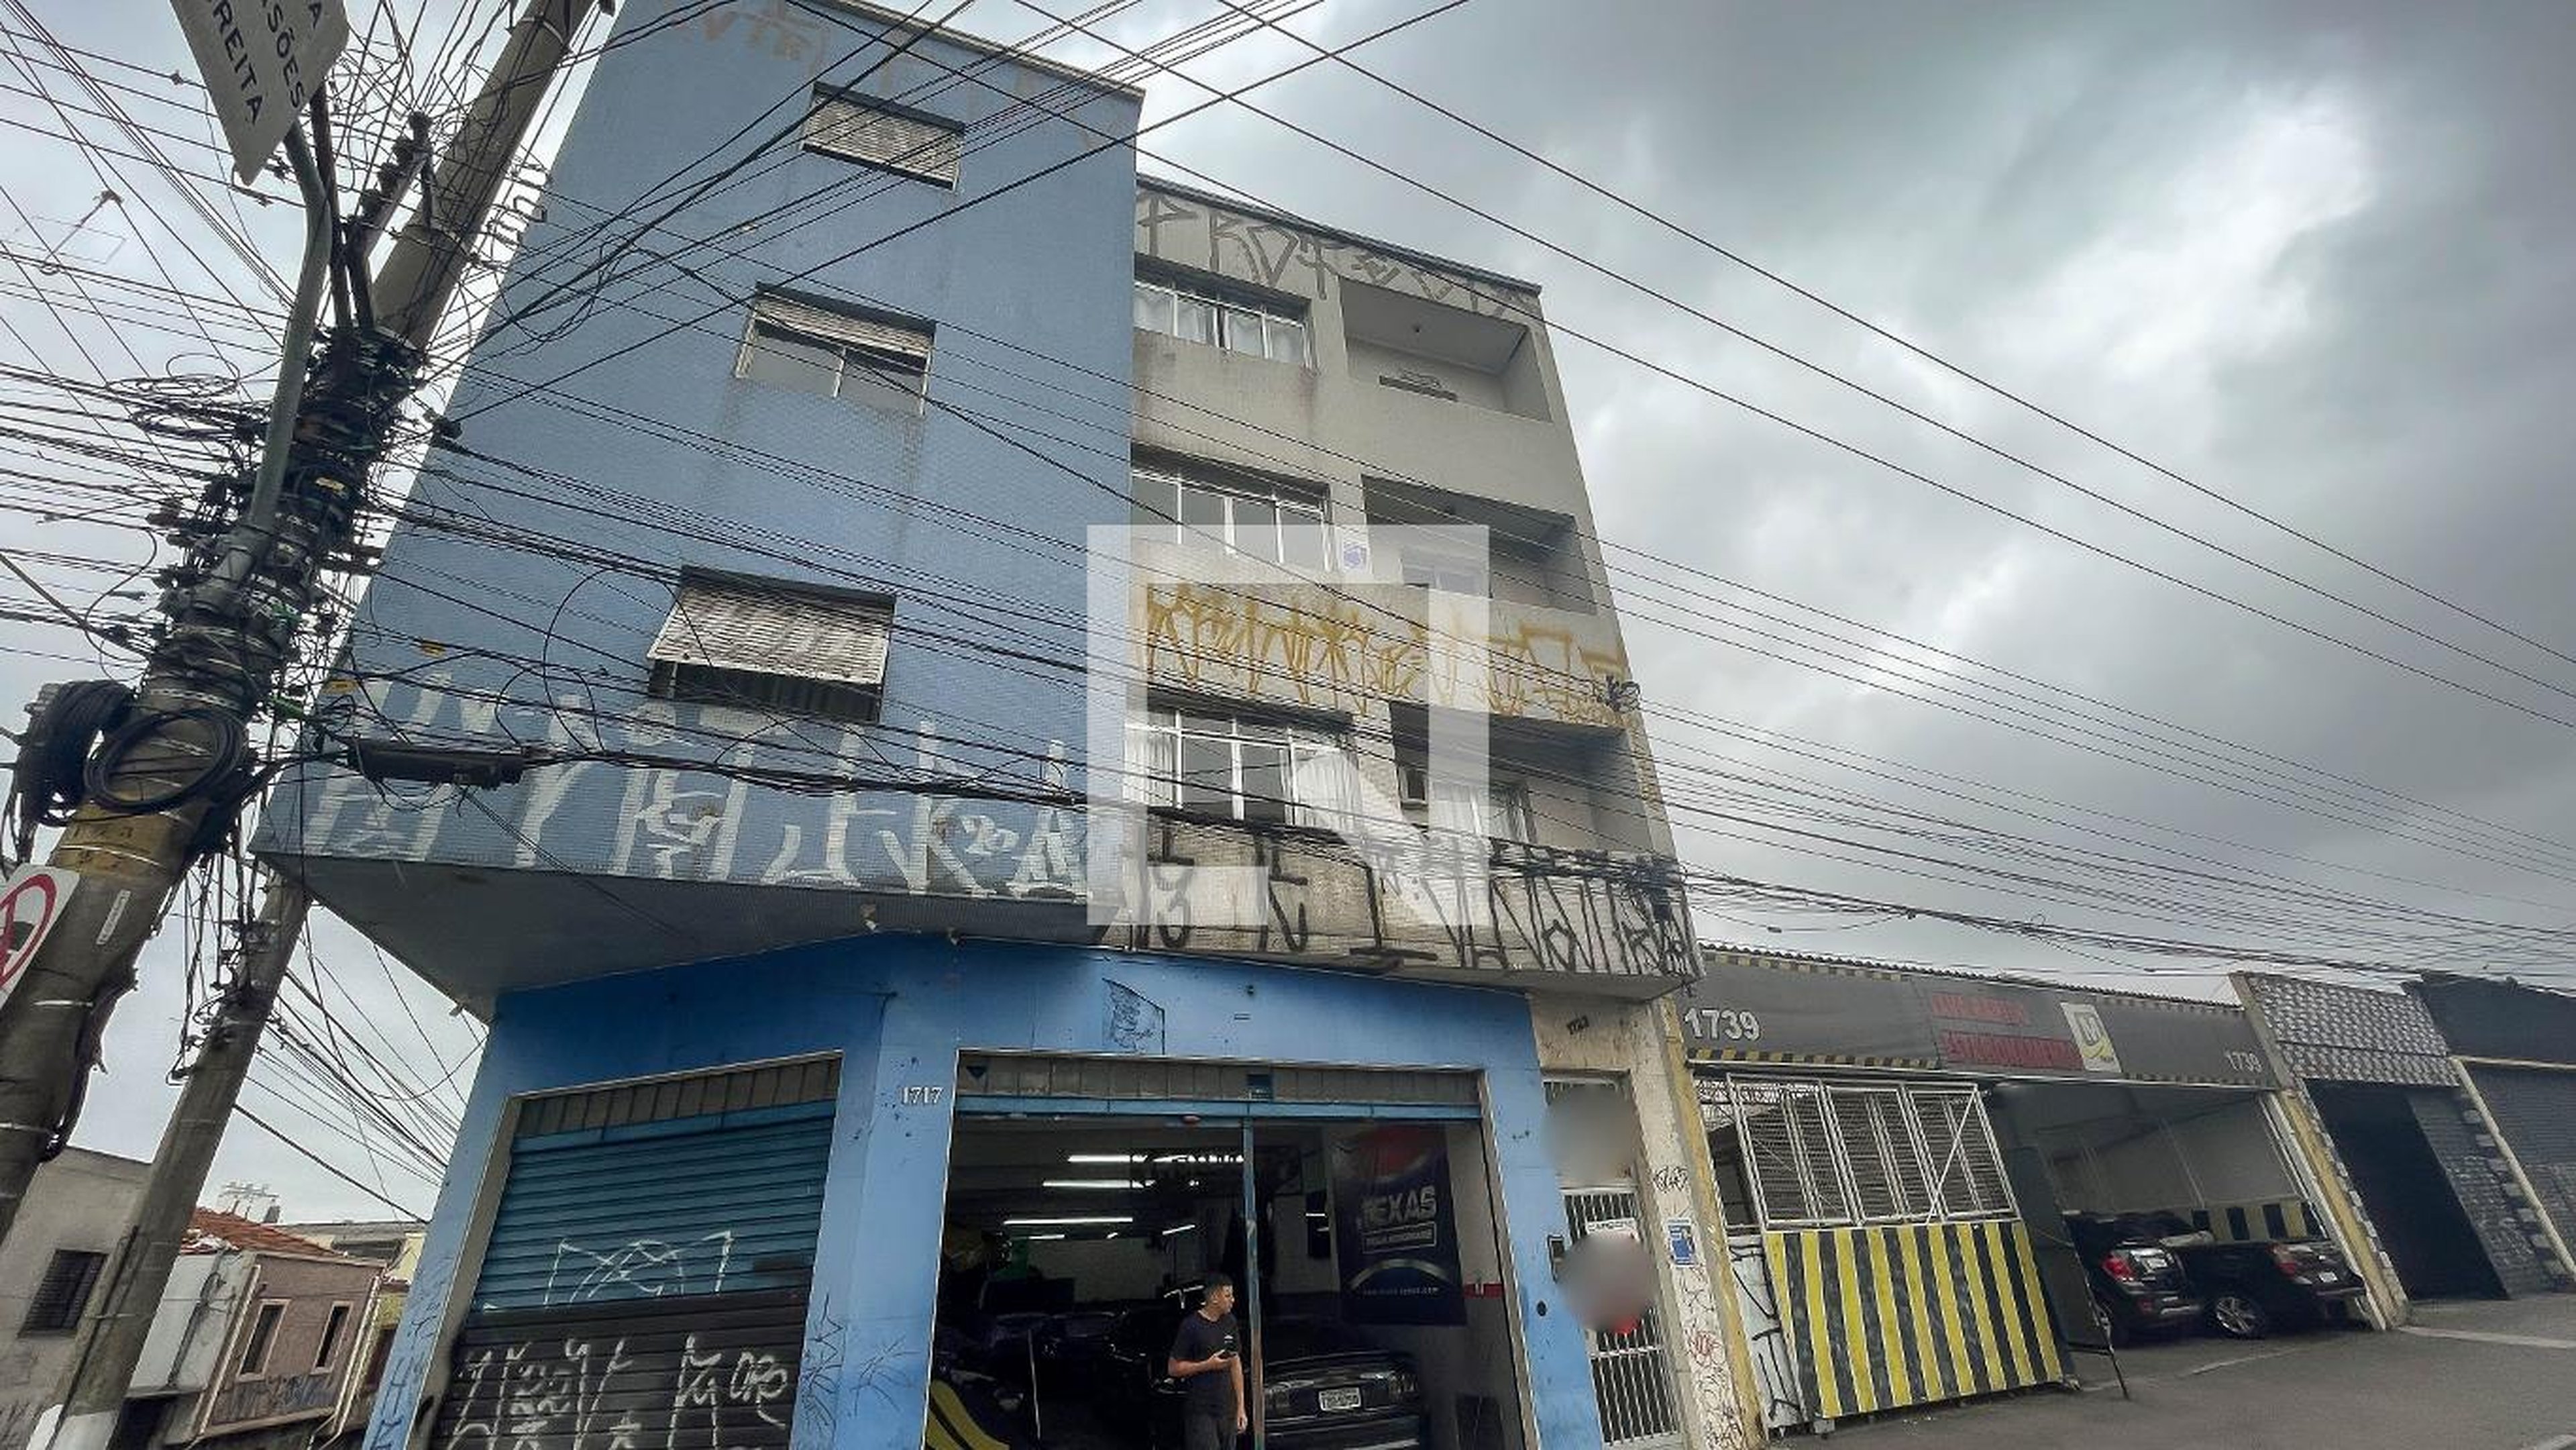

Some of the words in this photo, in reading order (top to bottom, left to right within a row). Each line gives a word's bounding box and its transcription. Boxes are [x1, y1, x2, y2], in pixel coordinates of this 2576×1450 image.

[208, 0, 263, 125] REITA
[262, 0, 304, 108] SÕES
[1684, 1007, 1760, 1041] 1739
[2224, 1050, 2262, 1073] 1739
[904, 1087, 943, 1104] 1717
[1361, 1185, 1436, 1228] TEXAS
